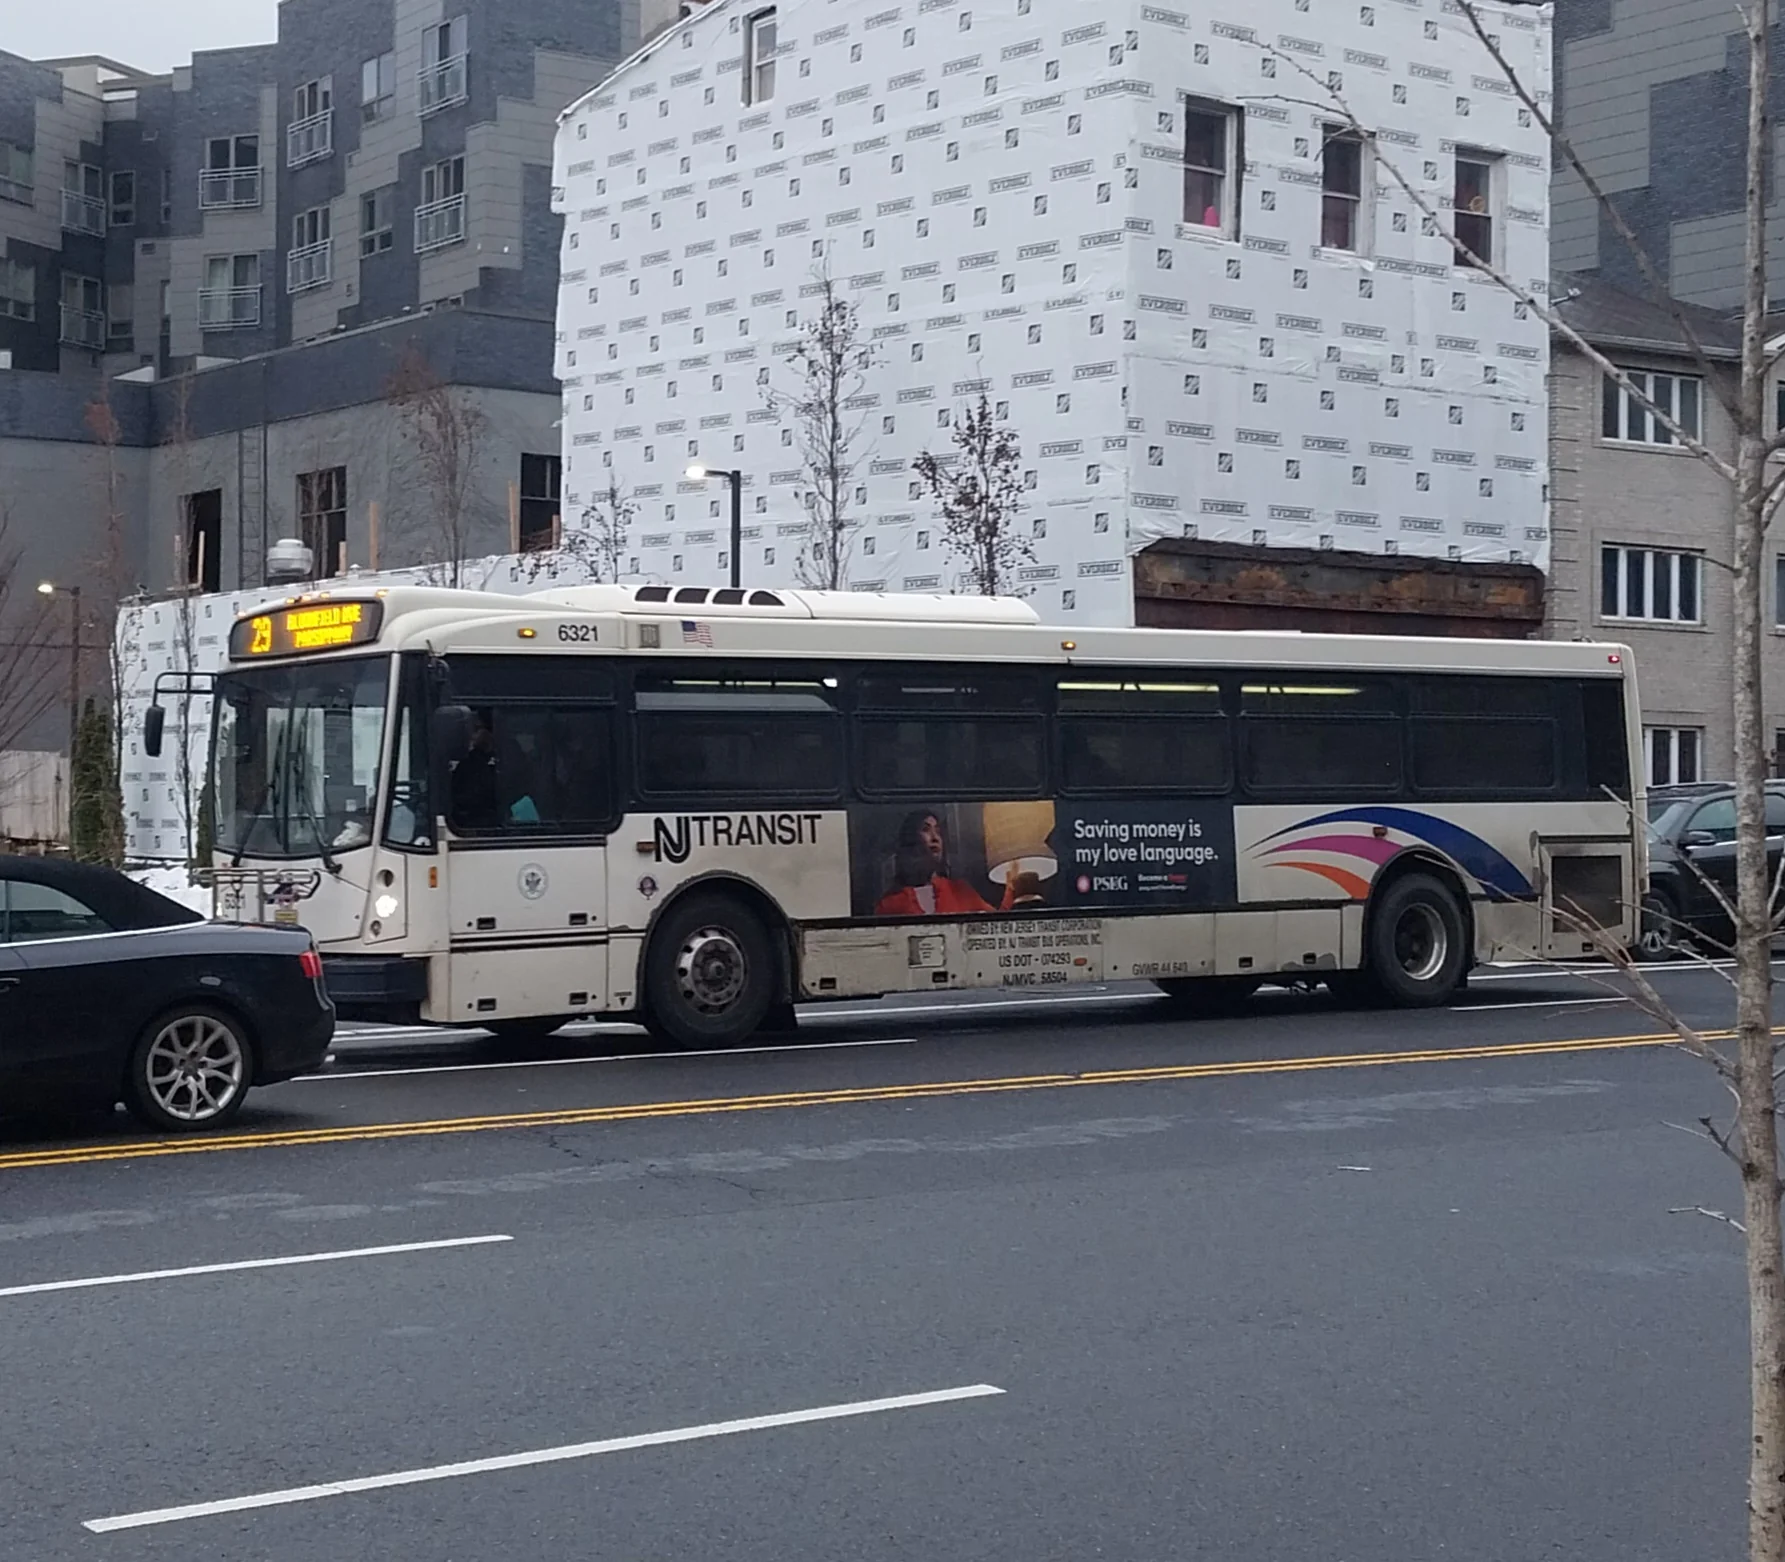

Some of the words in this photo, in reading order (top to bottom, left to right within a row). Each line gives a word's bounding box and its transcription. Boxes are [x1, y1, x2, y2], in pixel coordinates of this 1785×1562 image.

[558, 625, 598, 641] 6321
[654, 816, 691, 863] NJ
[692, 814, 822, 846] TRANSIT
[1074, 819, 1129, 842] Saving
[1133, 823, 1186, 841] money
[1188, 818, 1202, 837] is
[1076, 847, 1101, 867] my
[1104, 843, 1137, 862] love
[1140, 842, 1219, 866] language.
[1093, 876, 1128, 891] PSEG
[999, 955, 1011, 967] US
[1014, 954, 1032, 967] DOT
